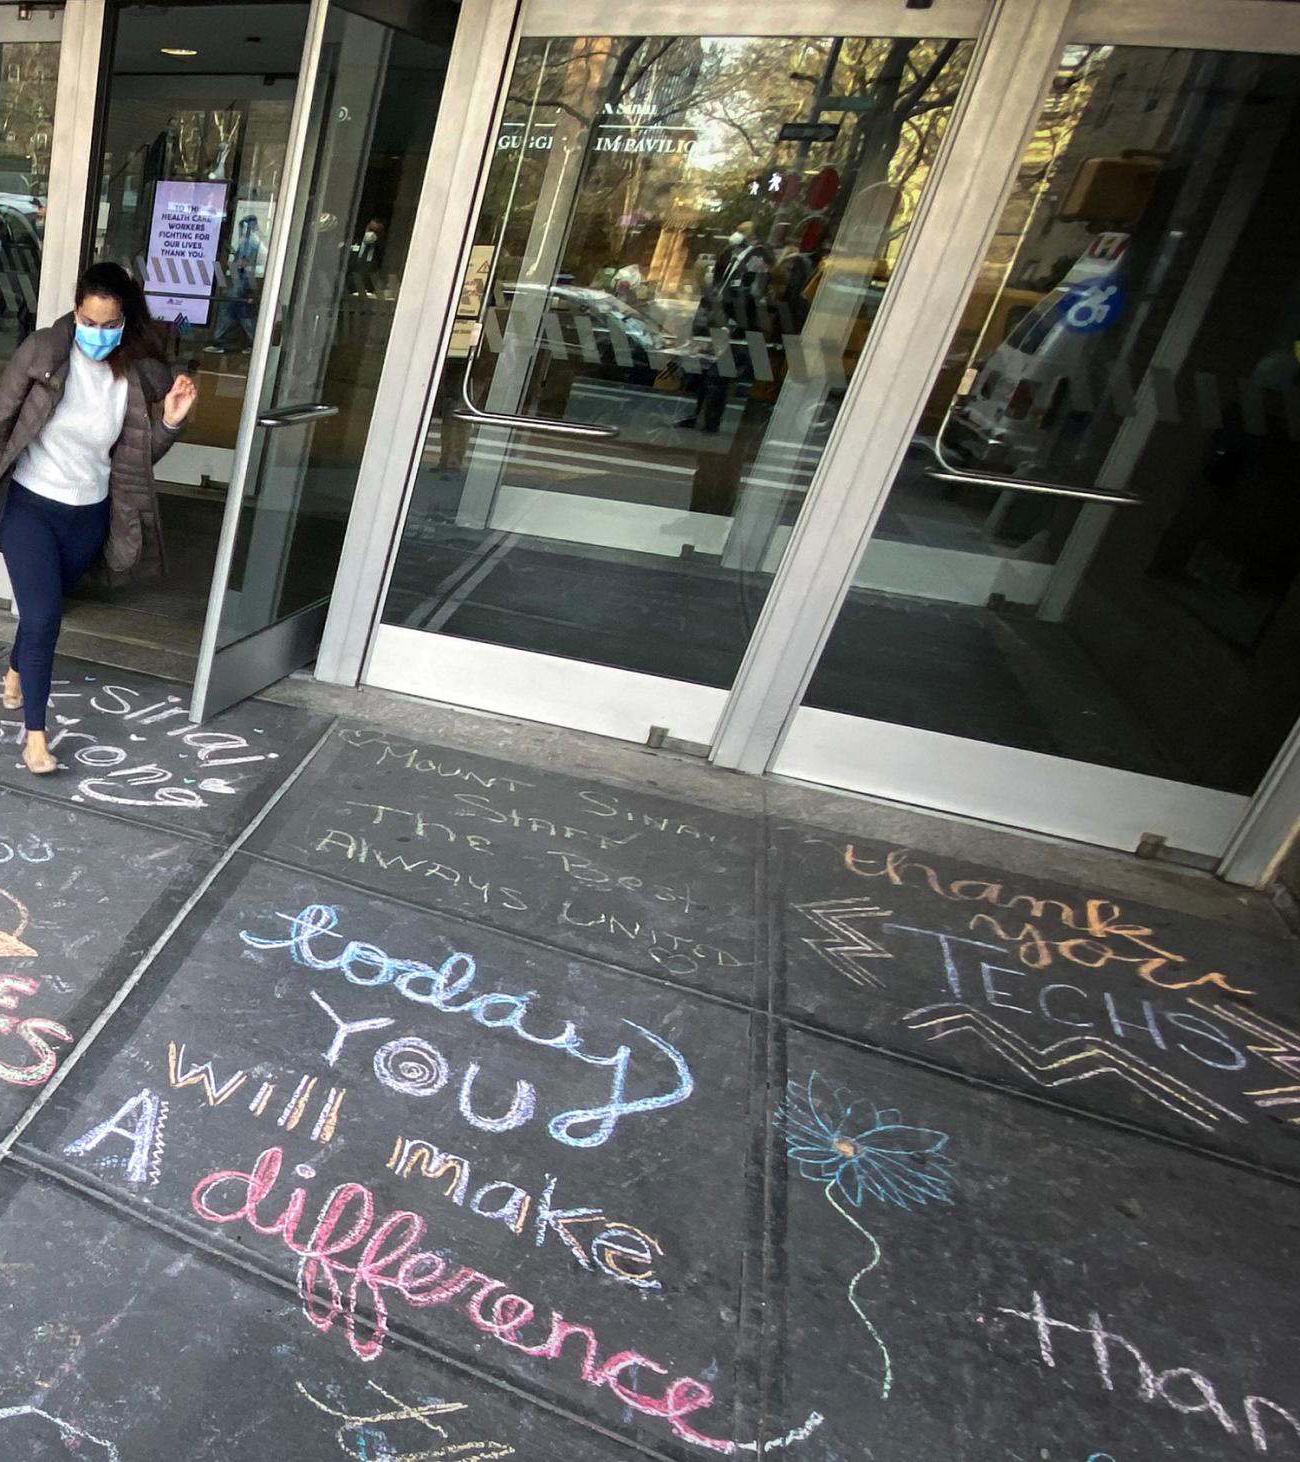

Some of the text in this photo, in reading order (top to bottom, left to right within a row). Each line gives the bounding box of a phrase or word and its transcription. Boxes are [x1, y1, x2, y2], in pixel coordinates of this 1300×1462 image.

[158, 230, 210, 241] FIGHTING FOR
[160, 248, 186, 257] THANK
[161, 212, 191, 222] HEALTH
[163, 240, 180, 248] OUR
[168, 222, 206, 232] WORKERS
[844, 843, 1258, 996] thank you
[239, 902, 695, 1149] today
[310, 991, 536, 1133] YOU
[882, 922, 1247, 1071] TECHS
[166, 1040, 665, 1291] will make
[63, 1087, 825, 1456] A difference
